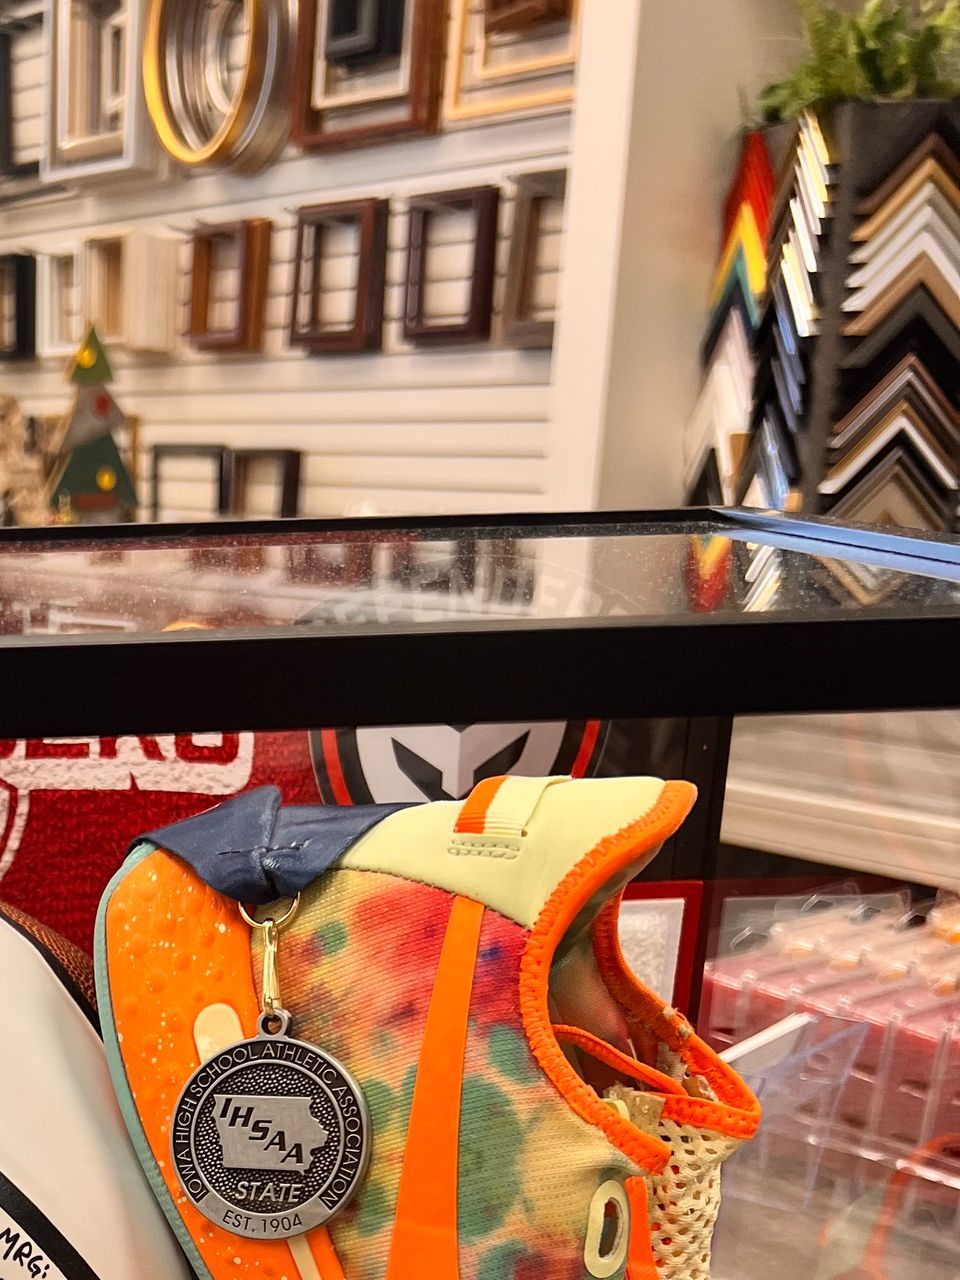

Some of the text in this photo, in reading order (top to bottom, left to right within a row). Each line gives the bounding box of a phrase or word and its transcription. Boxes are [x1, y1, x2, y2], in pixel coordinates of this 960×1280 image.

[175, 1042, 362, 1207] IOWA HIGH SCHOOL ATHLETIC ASSOCIATION
[219, 1098, 304, 1165] IHSAA
[235, 1180, 303, 1203] STATE
[222, 1209, 303, 1233] EST. 1904
